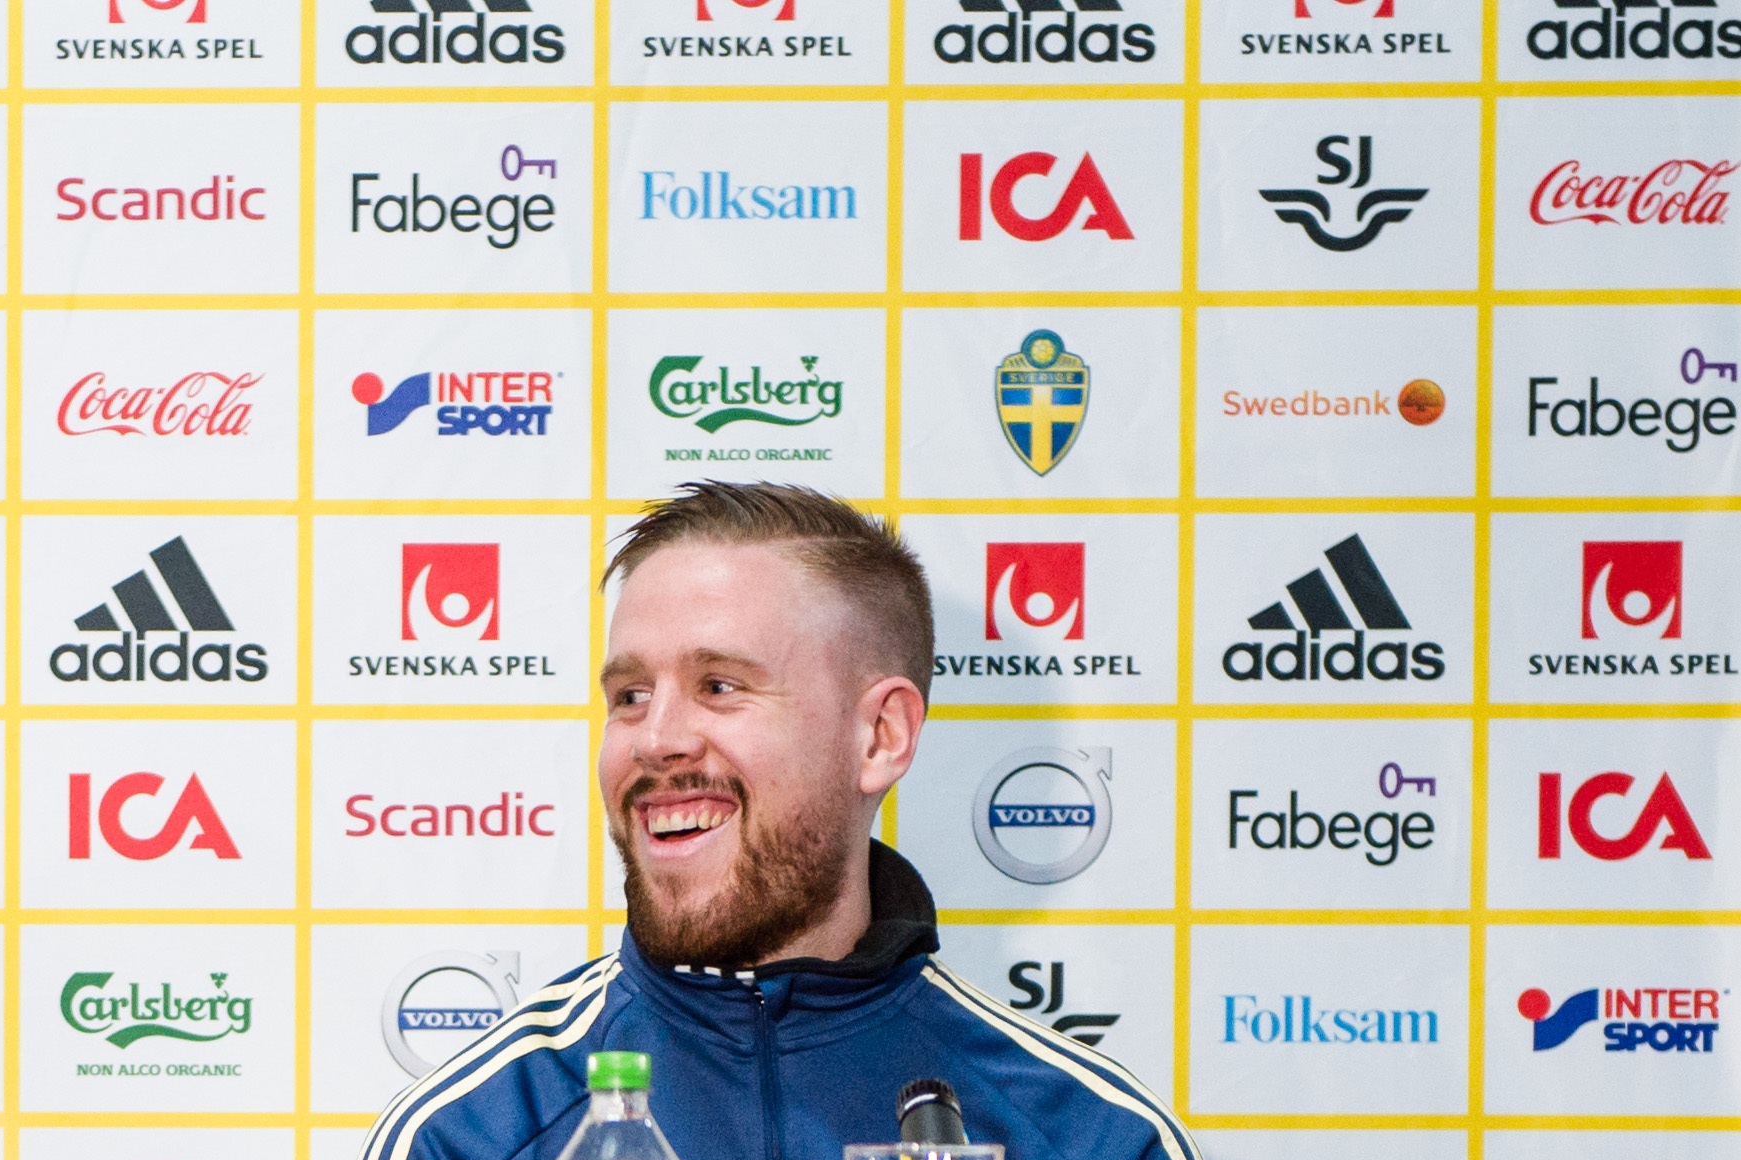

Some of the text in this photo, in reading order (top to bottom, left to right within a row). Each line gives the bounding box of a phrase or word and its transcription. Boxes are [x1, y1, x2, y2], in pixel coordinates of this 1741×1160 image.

[56, 39, 262, 59] SVENSKA SPEL
[345, 14, 565, 64] adidas
[644, 36, 851, 57] SVENSKA SPEL
[934, 14, 1156, 63] adidas
[1242, 33, 1450, 54] SVENSKA SPEL
[1527, 10, 1741, 60] adidas
[1316, 135, 1372, 188] SJ
[57, 175, 265, 221] Scandic
[352, 172, 556, 249] Fabege
[639, 172, 855, 219] Folksam
[960, 152, 1134, 241] ICA
[1529, 159, 1737, 226] Coca-Cola
[56, 371, 267, 437] Coca-Cola
[438, 372, 552, 403] INTER
[648, 354, 843, 418] Carlsberg
[1224, 390, 1390, 416] Swedbank
[437, 405, 552, 436] SPORT
[1529, 376, 1737, 453] Fabege
[666, 449, 831, 461] NON ALCO ORGANIC
[49, 631, 268, 682] adidas
[350, 656, 555, 676] SVENSKA SPEL
[933, 655, 1140, 677] SVENSKA SPEL
[1222, 630, 1445, 681] adidas
[1529, 654, 1737, 675] SVENSKA SPEL
[69, 772, 241, 861] ICA
[346, 792, 554, 837] Scandic
[994, 807, 1091, 824] VOLVO
[1229, 788, 1435, 866] Fabege
[1539, 772, 1711, 860] ICA
[60, 970, 253, 1036] Carlsberg
[1008, 961, 1063, 1014] SJ
[1605, 989, 1718, 1019] INTER
[402, 1010, 499, 1029] VOLVO
[1221, 996, 1437, 1042] Folksam
[1604, 1022, 1719, 1052] SPORT
[77, 1064, 241, 1076] NON ALCO ORGANIC
